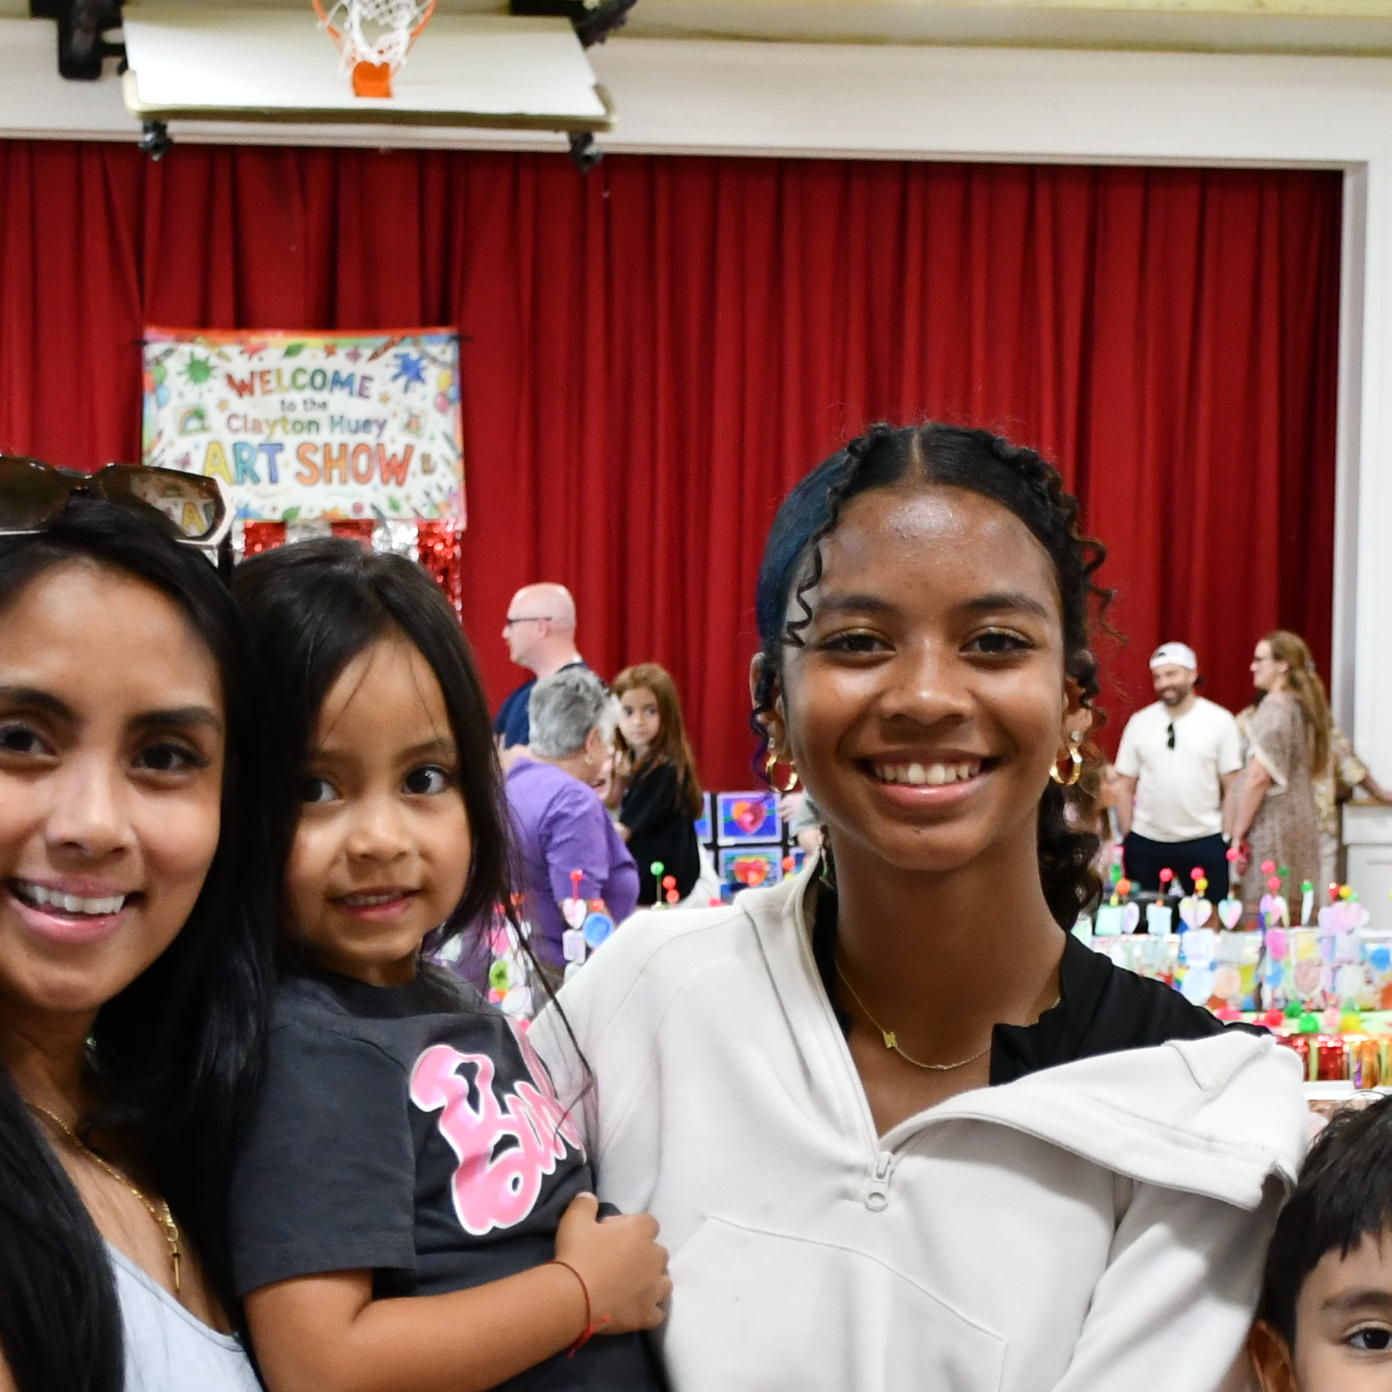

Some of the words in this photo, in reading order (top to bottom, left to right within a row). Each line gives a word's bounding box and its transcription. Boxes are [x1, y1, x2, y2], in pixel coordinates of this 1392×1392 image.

[225, 367, 374, 398] WELCOME
[280, 398, 296, 412] to
[301, 399, 329, 412] the
[226, 412, 321, 439] Clayton
[329, 414, 388, 439] Huey
[202, 441, 285, 486] ART
[295, 442, 414, 487] SHOW
